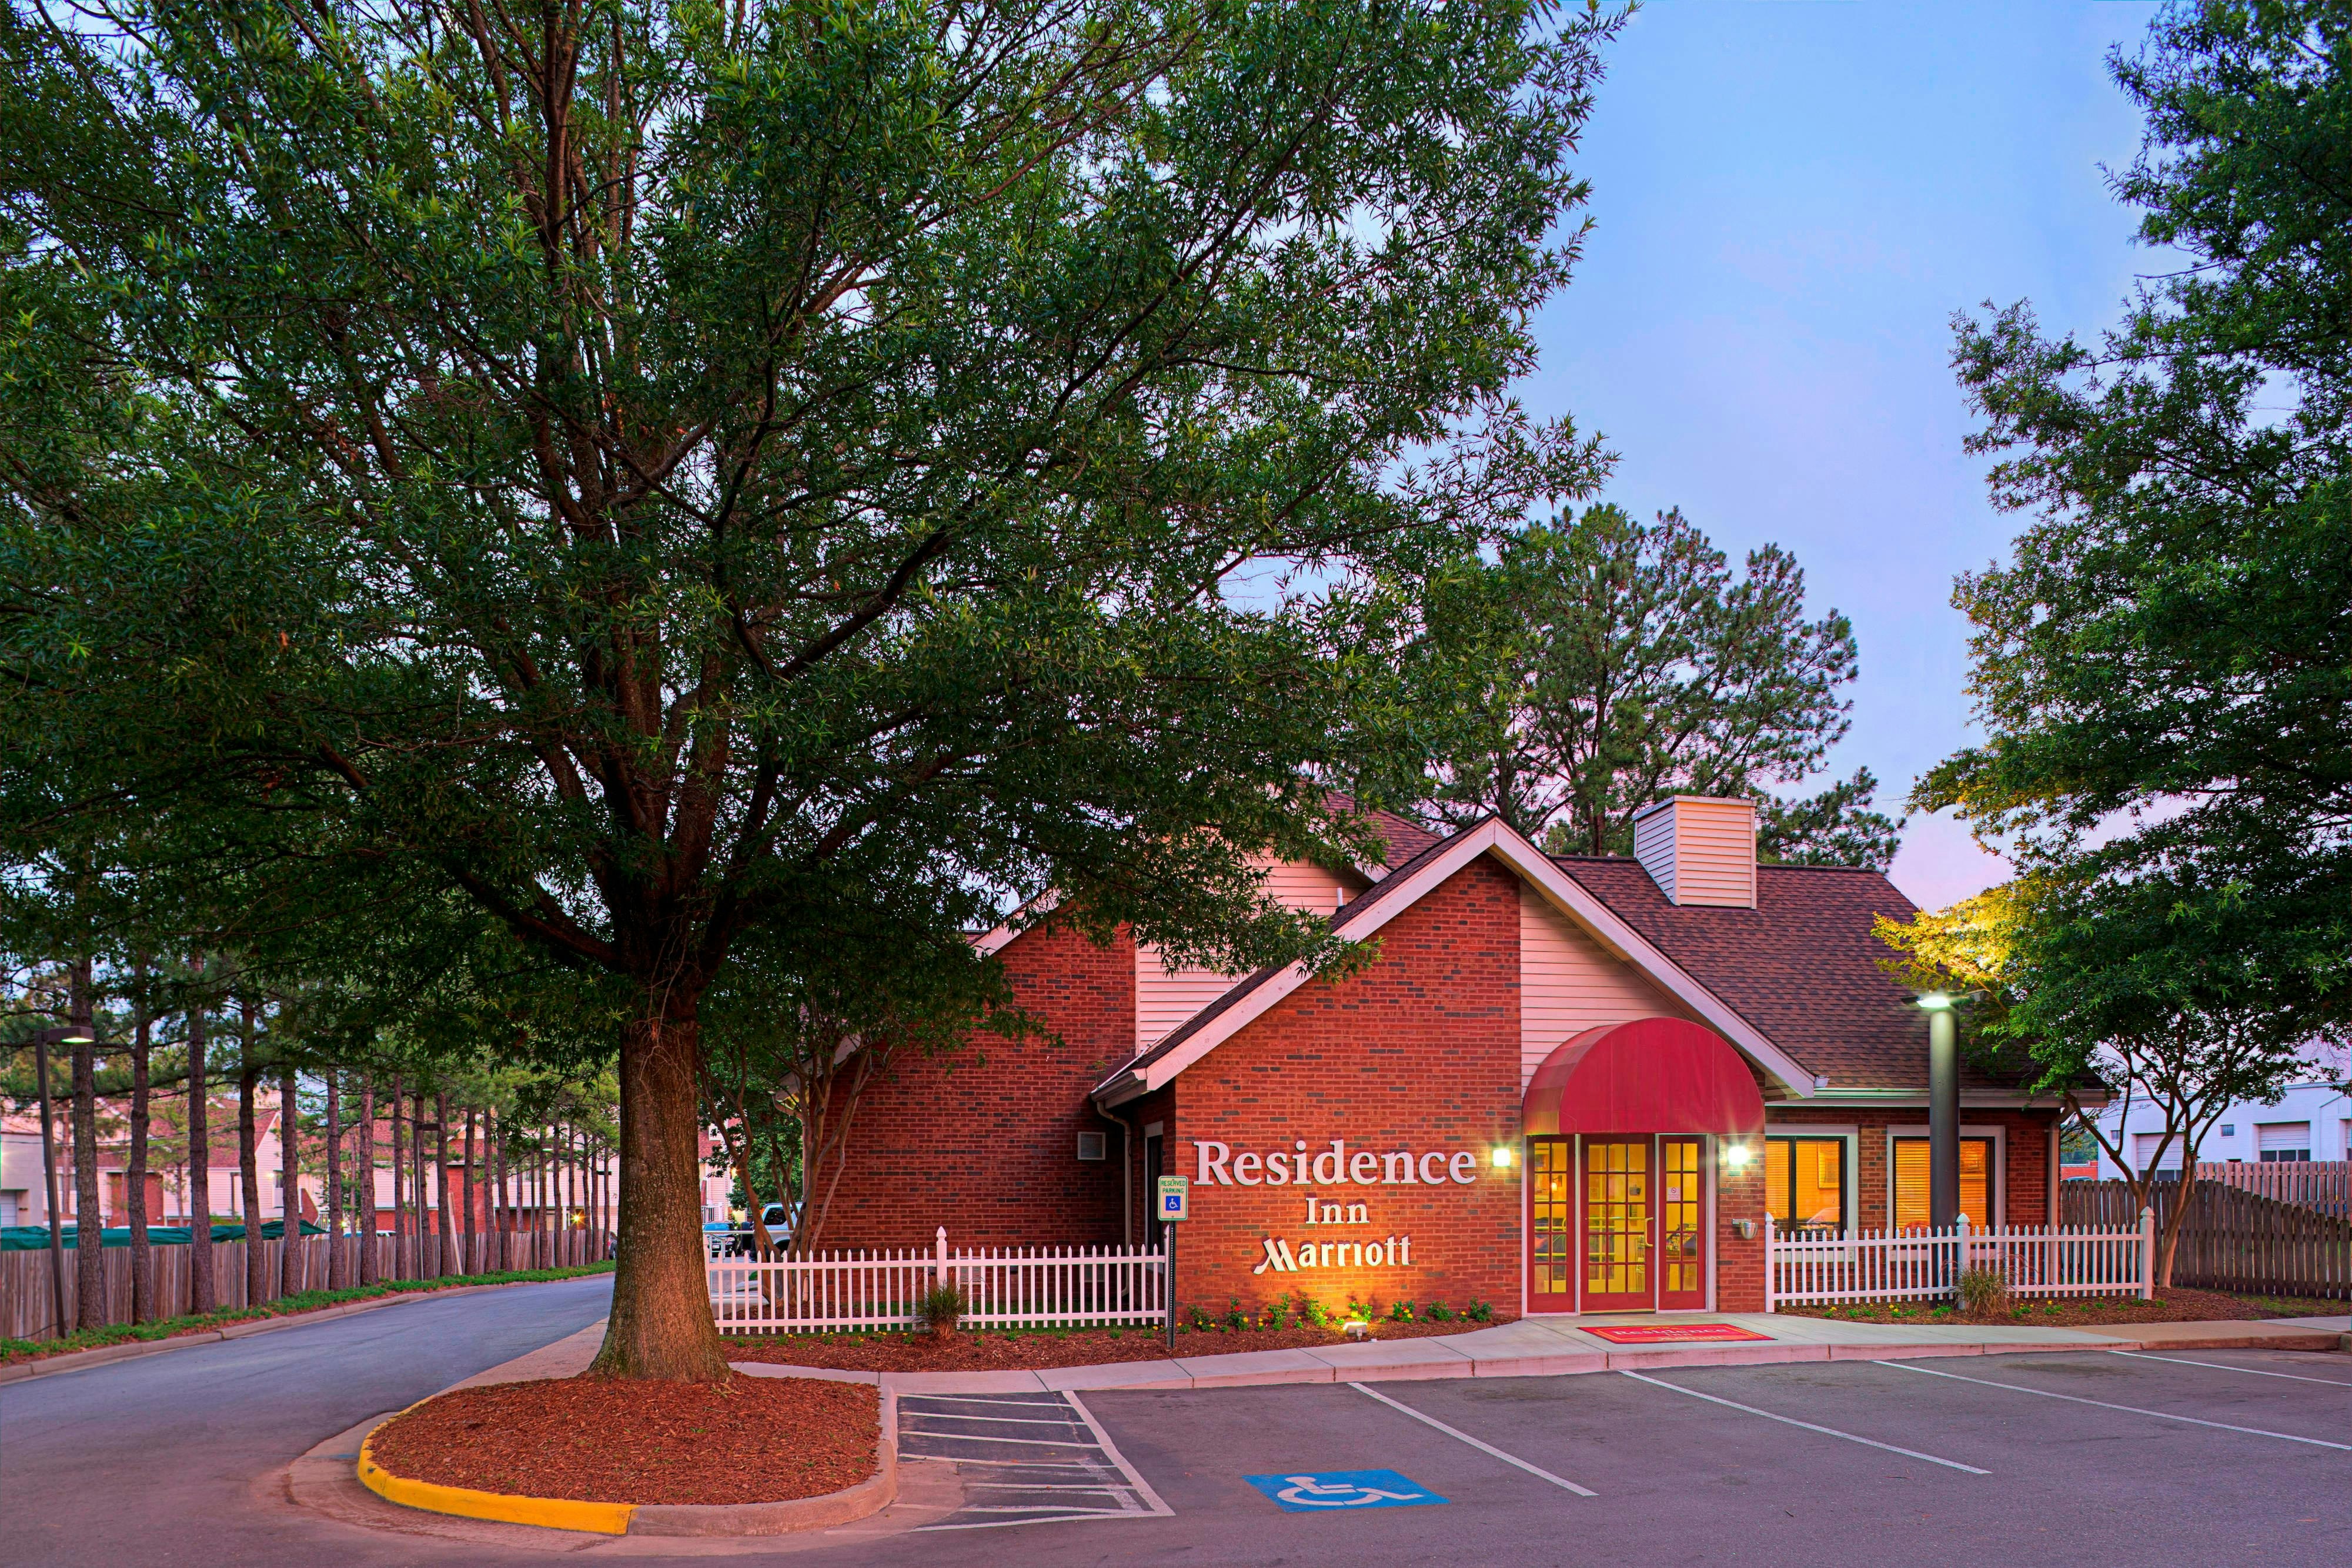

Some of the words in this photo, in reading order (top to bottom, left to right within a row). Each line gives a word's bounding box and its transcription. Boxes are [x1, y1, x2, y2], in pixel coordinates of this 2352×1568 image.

[1193, 1139, 1476, 1185] Residence
[1305, 1197, 1370, 1224] Inn
[1254, 1235, 1411, 1275] Marriott
